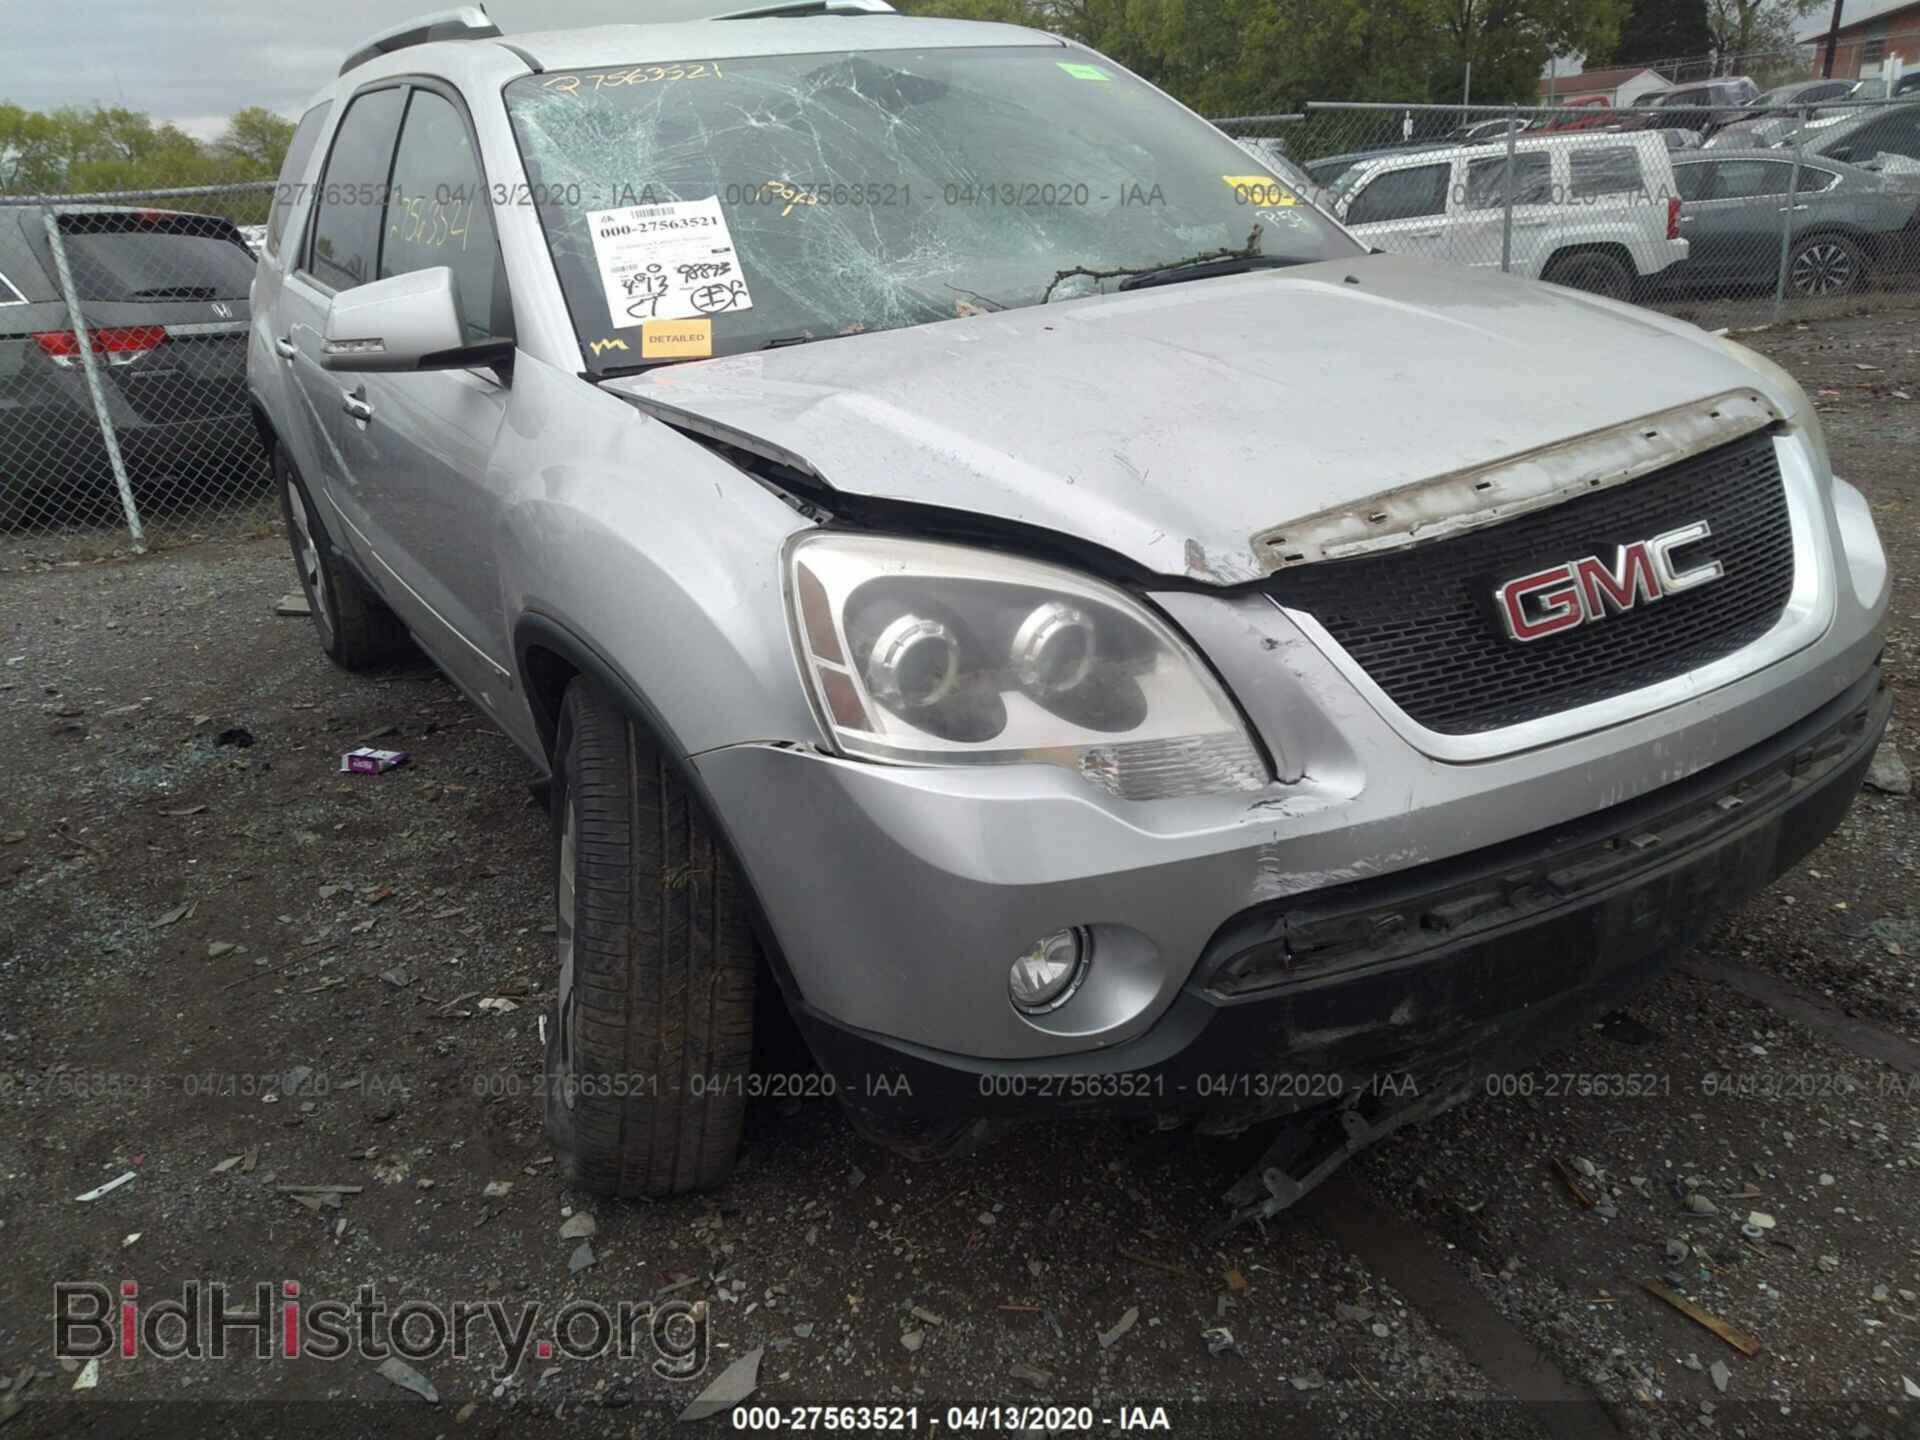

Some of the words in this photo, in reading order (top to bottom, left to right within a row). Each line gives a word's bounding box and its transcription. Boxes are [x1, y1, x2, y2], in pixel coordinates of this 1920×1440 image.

[600, 216, 718, 238] 000-27563521
[649, 334, 705, 344] DETAILED
[1496, 519, 1725, 642] GMC
